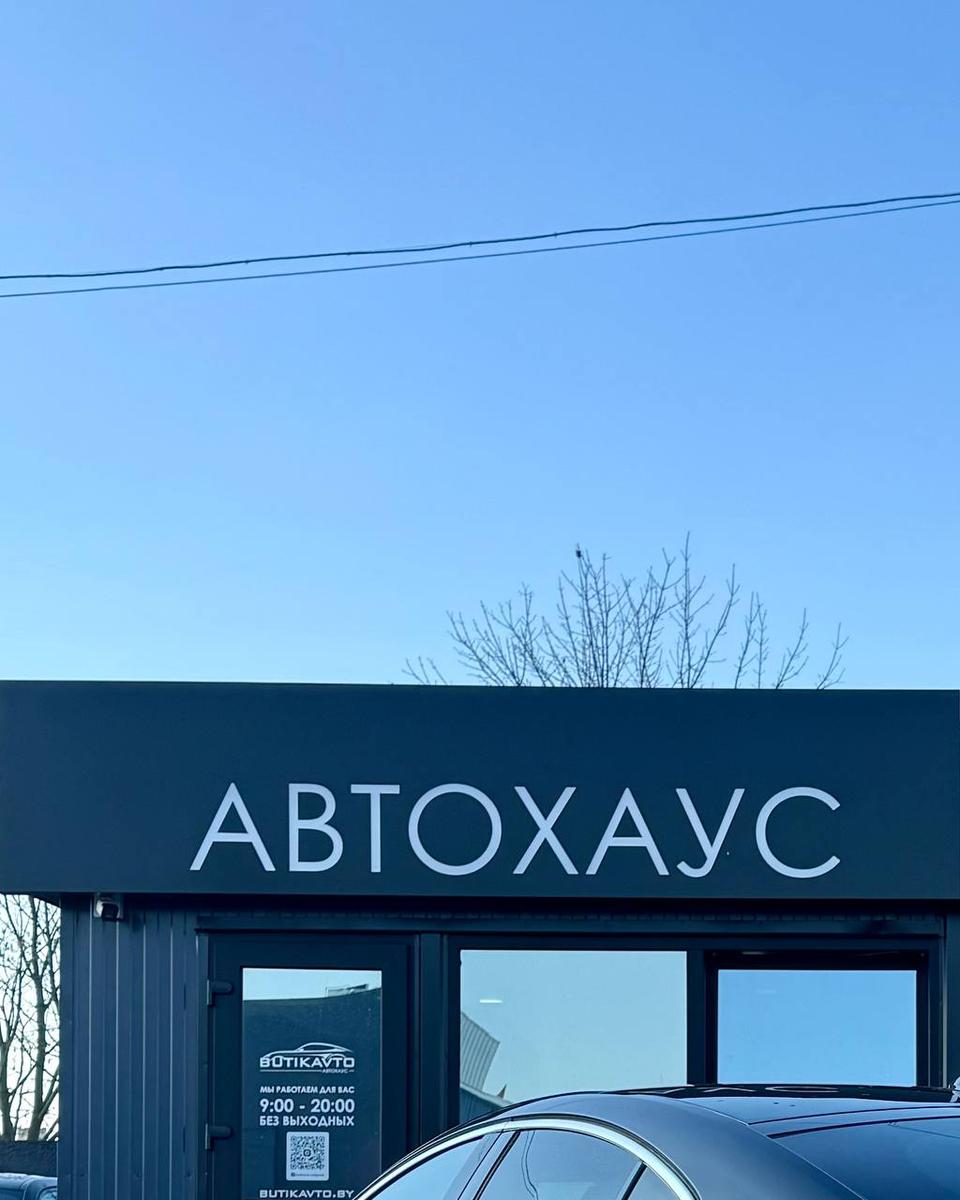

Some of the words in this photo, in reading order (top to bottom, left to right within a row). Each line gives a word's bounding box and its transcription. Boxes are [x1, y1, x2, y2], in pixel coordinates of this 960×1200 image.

[190, 782, 842, 879] АВТОХАУС
[259, 1056, 355, 1068] BUTIKAVTO
[259, 1086, 275, 1094] МЫ
[276, 1086, 318, 1094] РАБОТАЕМ
[319, 1086, 337, 1095] ДЛЯ
[338, 1086, 355, 1094] ВАС
[259, 1099, 294, 1113] 9:00
[310, 1099, 355, 1113] 20:00
[259, 1116, 279, 1127] БЕЗ
[282, 1116, 355, 1128] ВЫХОДНЫХ
[259, 1189, 355, 1198] BUTIKAVTO.BY
